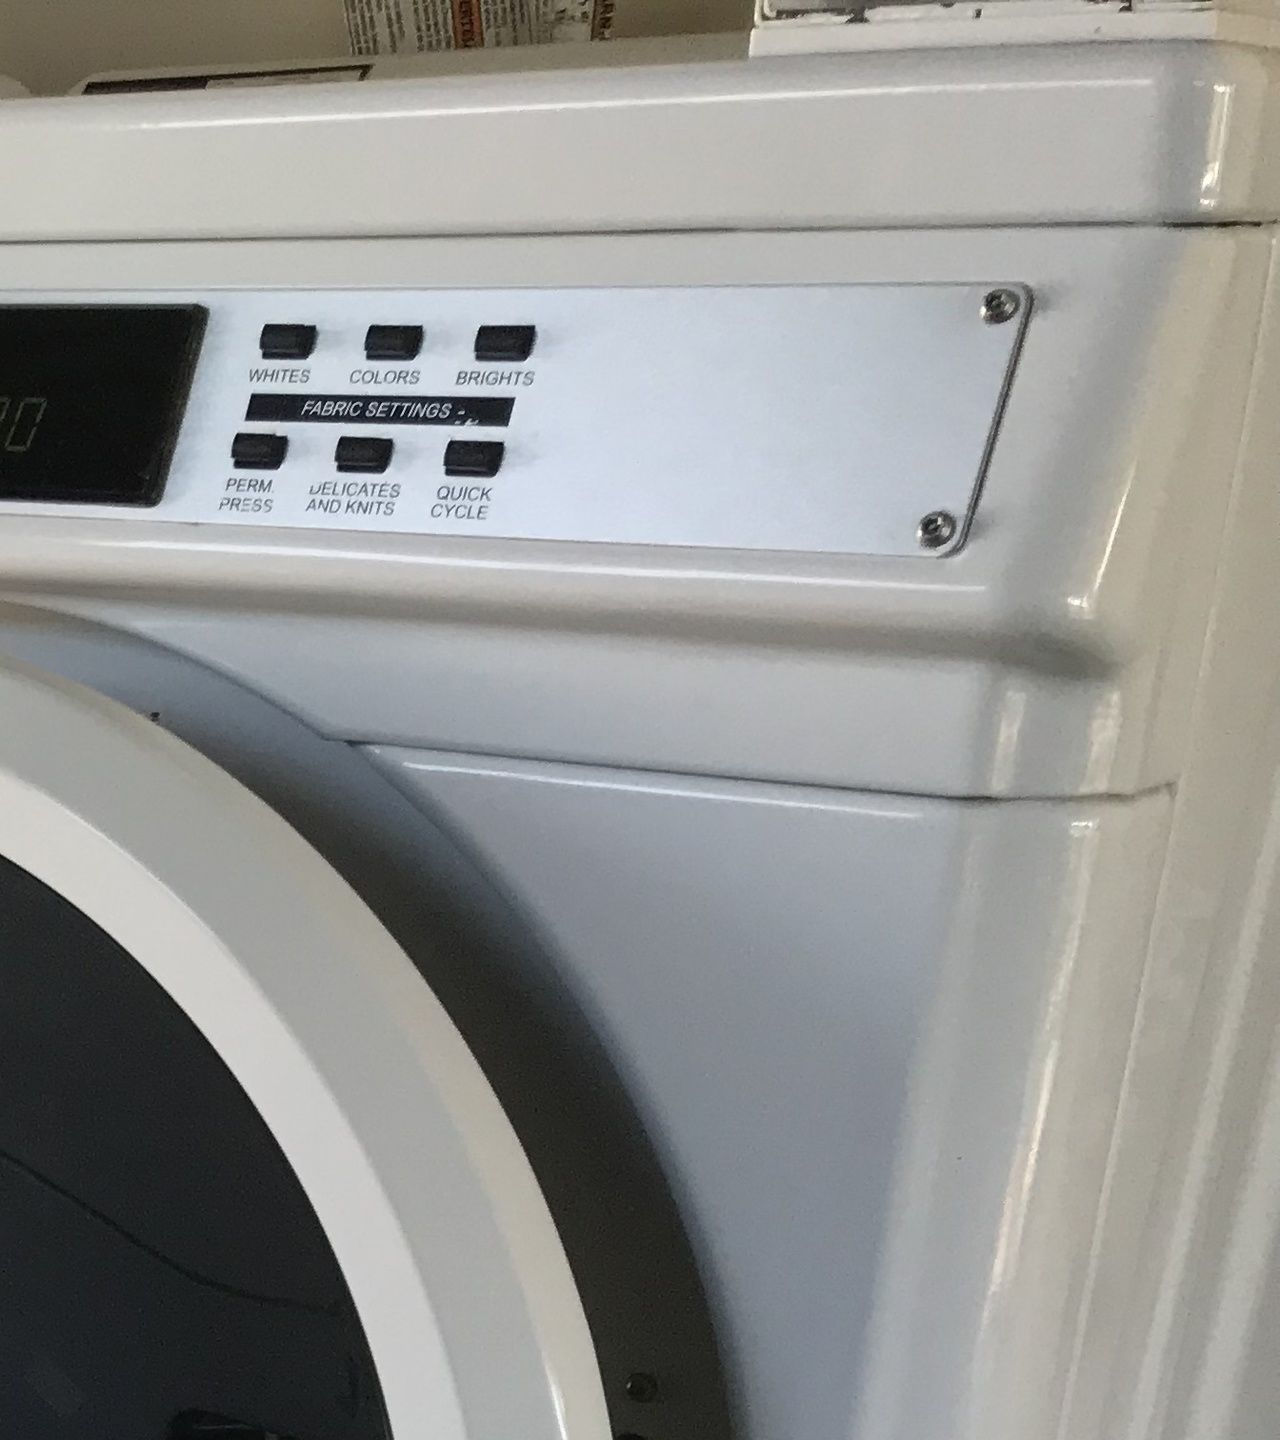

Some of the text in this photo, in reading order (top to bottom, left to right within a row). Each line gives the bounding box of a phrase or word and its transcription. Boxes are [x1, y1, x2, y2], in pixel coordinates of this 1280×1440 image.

[249, 368, 534, 386] WHITES COLORS BRIGHTS
[301, 400, 452, 419] FABRIC SETTINGS
[309, 481, 401, 498] DELICATES
[436, 486, 493, 502] QUICK
[219, 498, 274, 513] PRESS
[305, 499, 395, 516] AND KNITS
[430, 504, 489, 520] CYCLE
